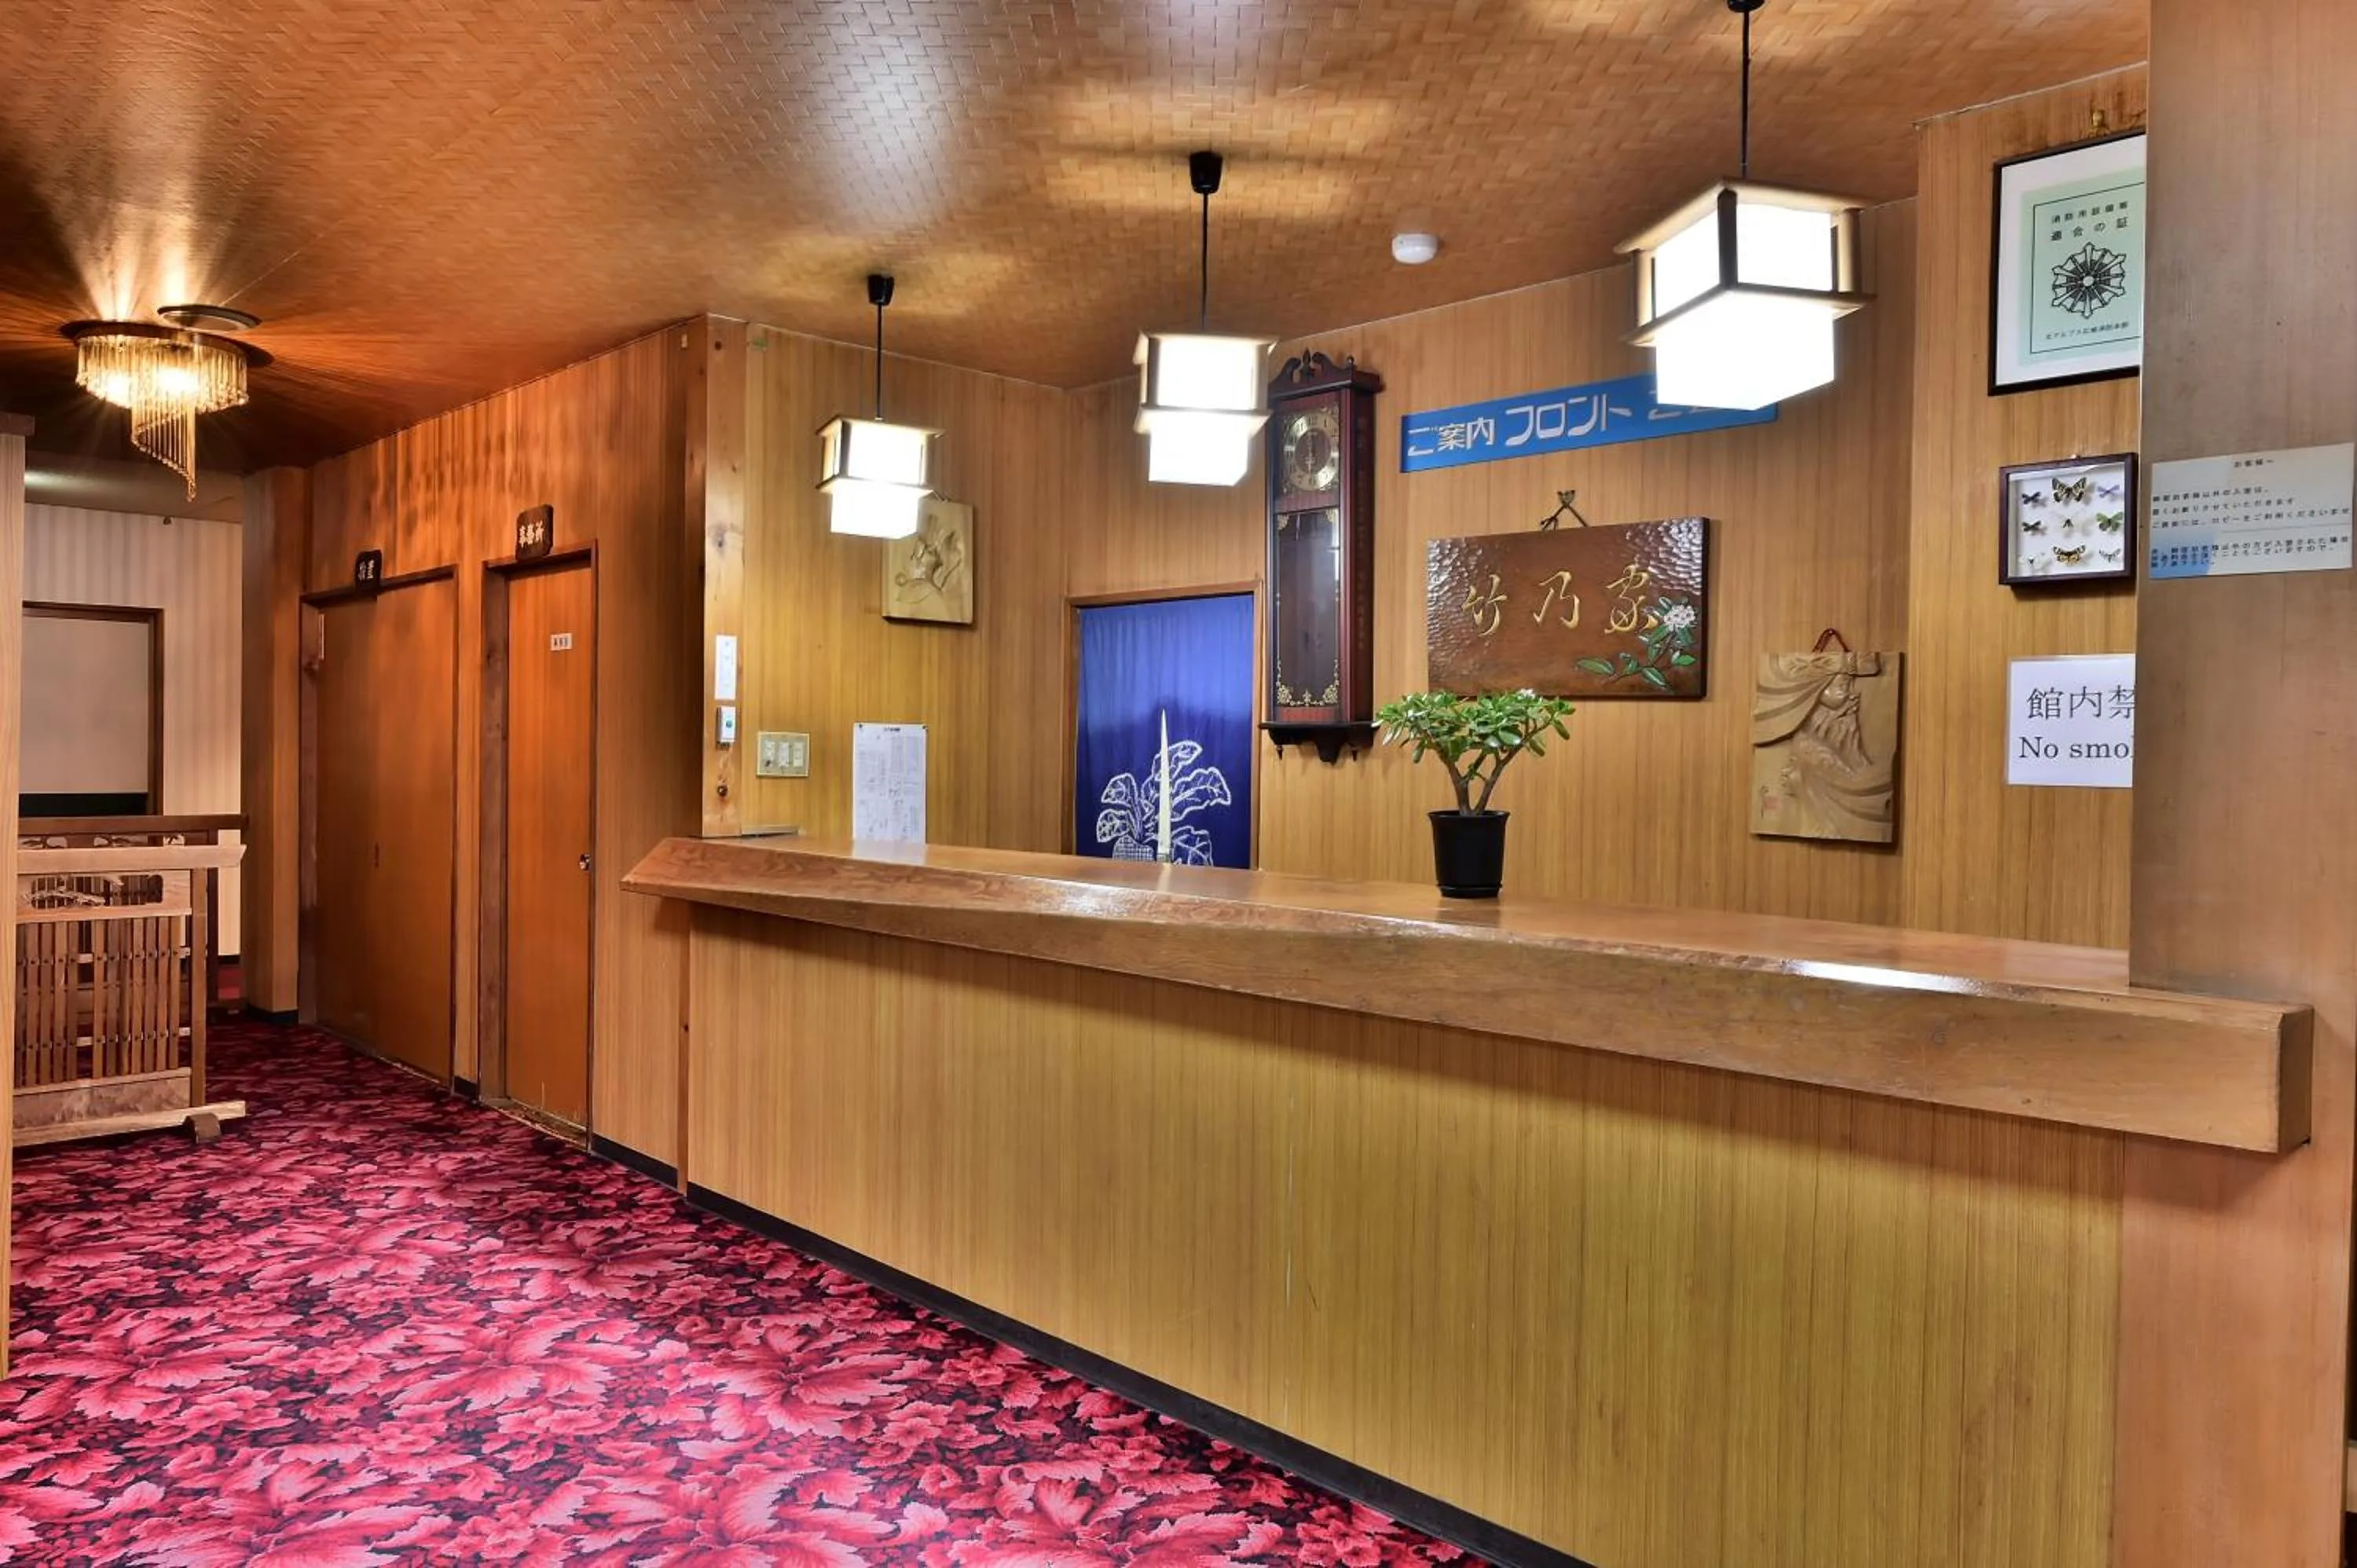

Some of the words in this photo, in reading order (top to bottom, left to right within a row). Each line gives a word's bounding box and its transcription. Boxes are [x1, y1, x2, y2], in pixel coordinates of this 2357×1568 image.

[1407, 417, 1495, 456] ご案内
[1505, 394, 1632, 445] フロント
[2018, 736, 2058, 759] No
[2069, 735, 2134, 759] smo
